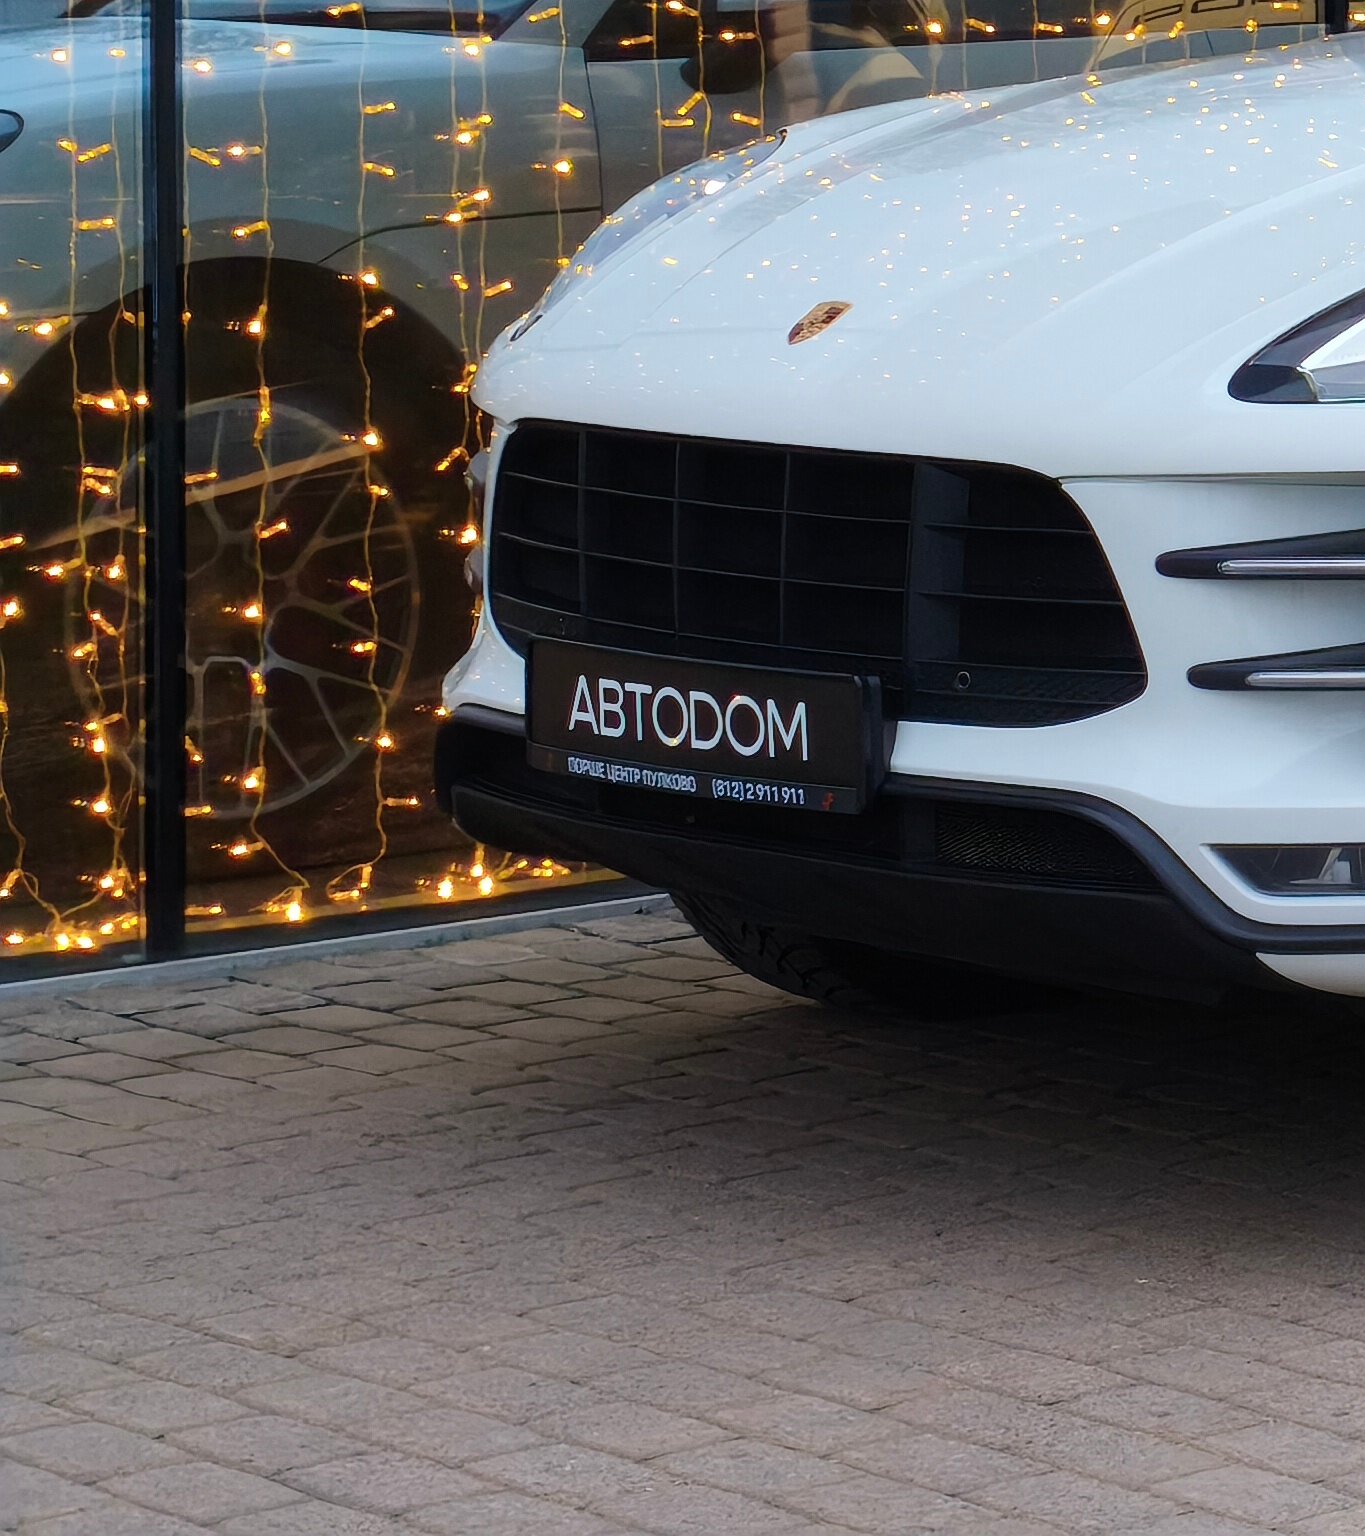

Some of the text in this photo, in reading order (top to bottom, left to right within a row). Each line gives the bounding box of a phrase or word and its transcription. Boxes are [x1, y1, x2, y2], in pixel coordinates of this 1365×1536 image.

[568, 674, 809, 761] ABTODOM
[567, 756, 697, 793] ПОРШЕ ЦЕНТР ПУЛКОВО
